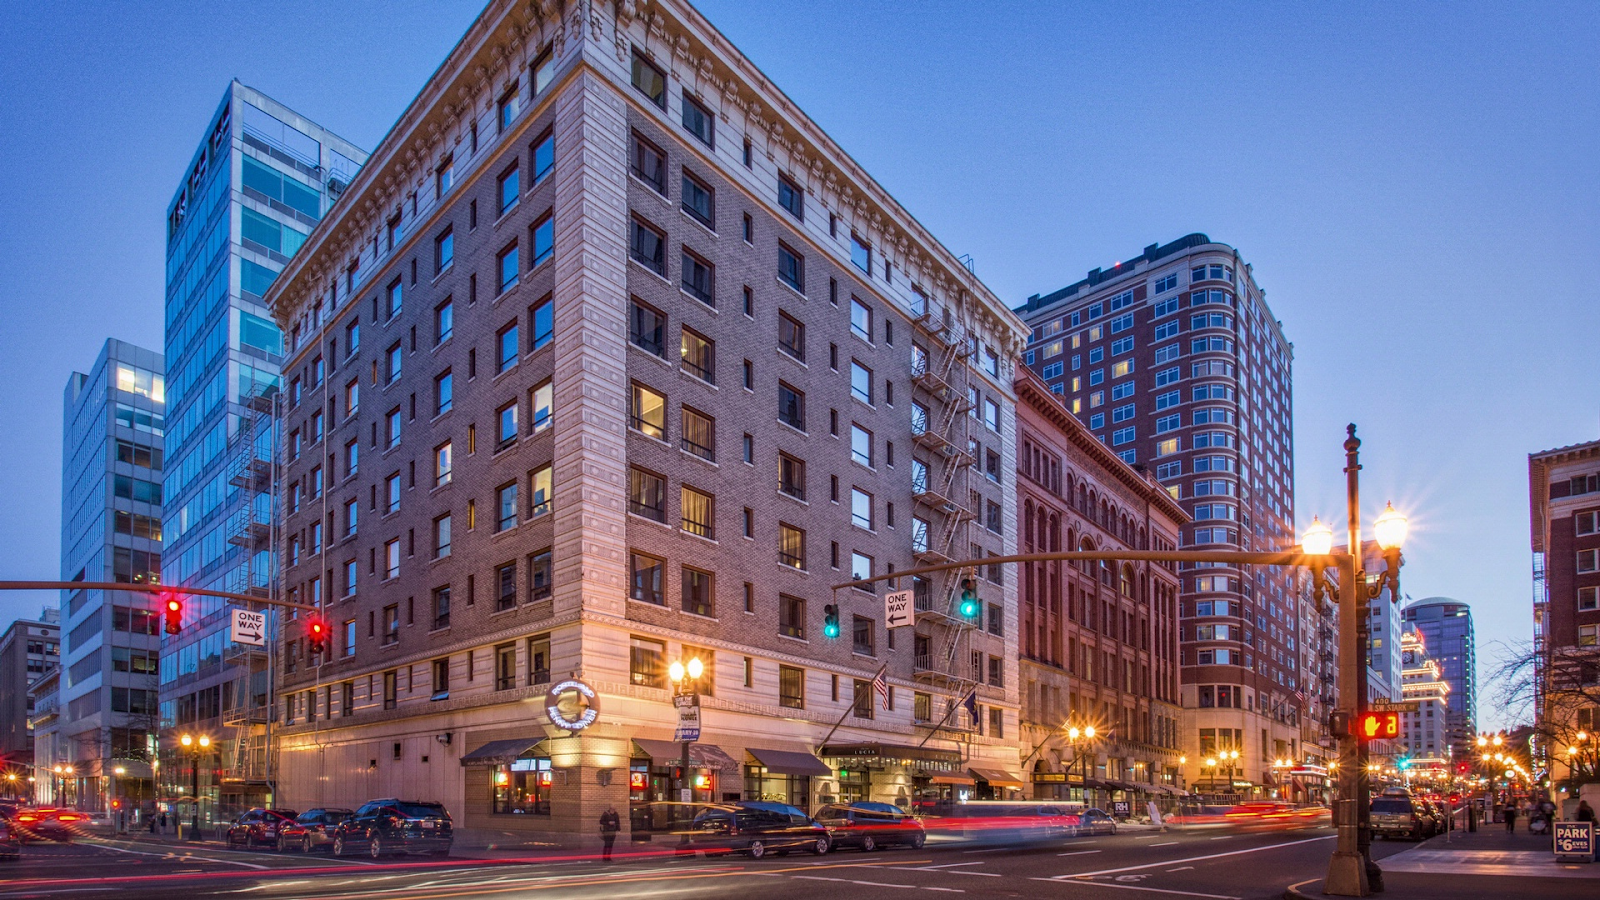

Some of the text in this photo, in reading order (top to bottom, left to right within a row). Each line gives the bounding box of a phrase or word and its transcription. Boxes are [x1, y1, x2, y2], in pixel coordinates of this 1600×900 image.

[888, 593, 907, 604] ONE
[888, 603, 907, 613] WAY
[238, 612, 262, 623] ONE
[238, 620, 262, 631] WAY
[1374, 704, 1385, 712] SW
[1386, 704, 1407, 712] STARK
[934, 754, 959, 762] LUCIA
[1115, 802, 1128, 811] RH
[1557, 828, 1588, 839] PARK
